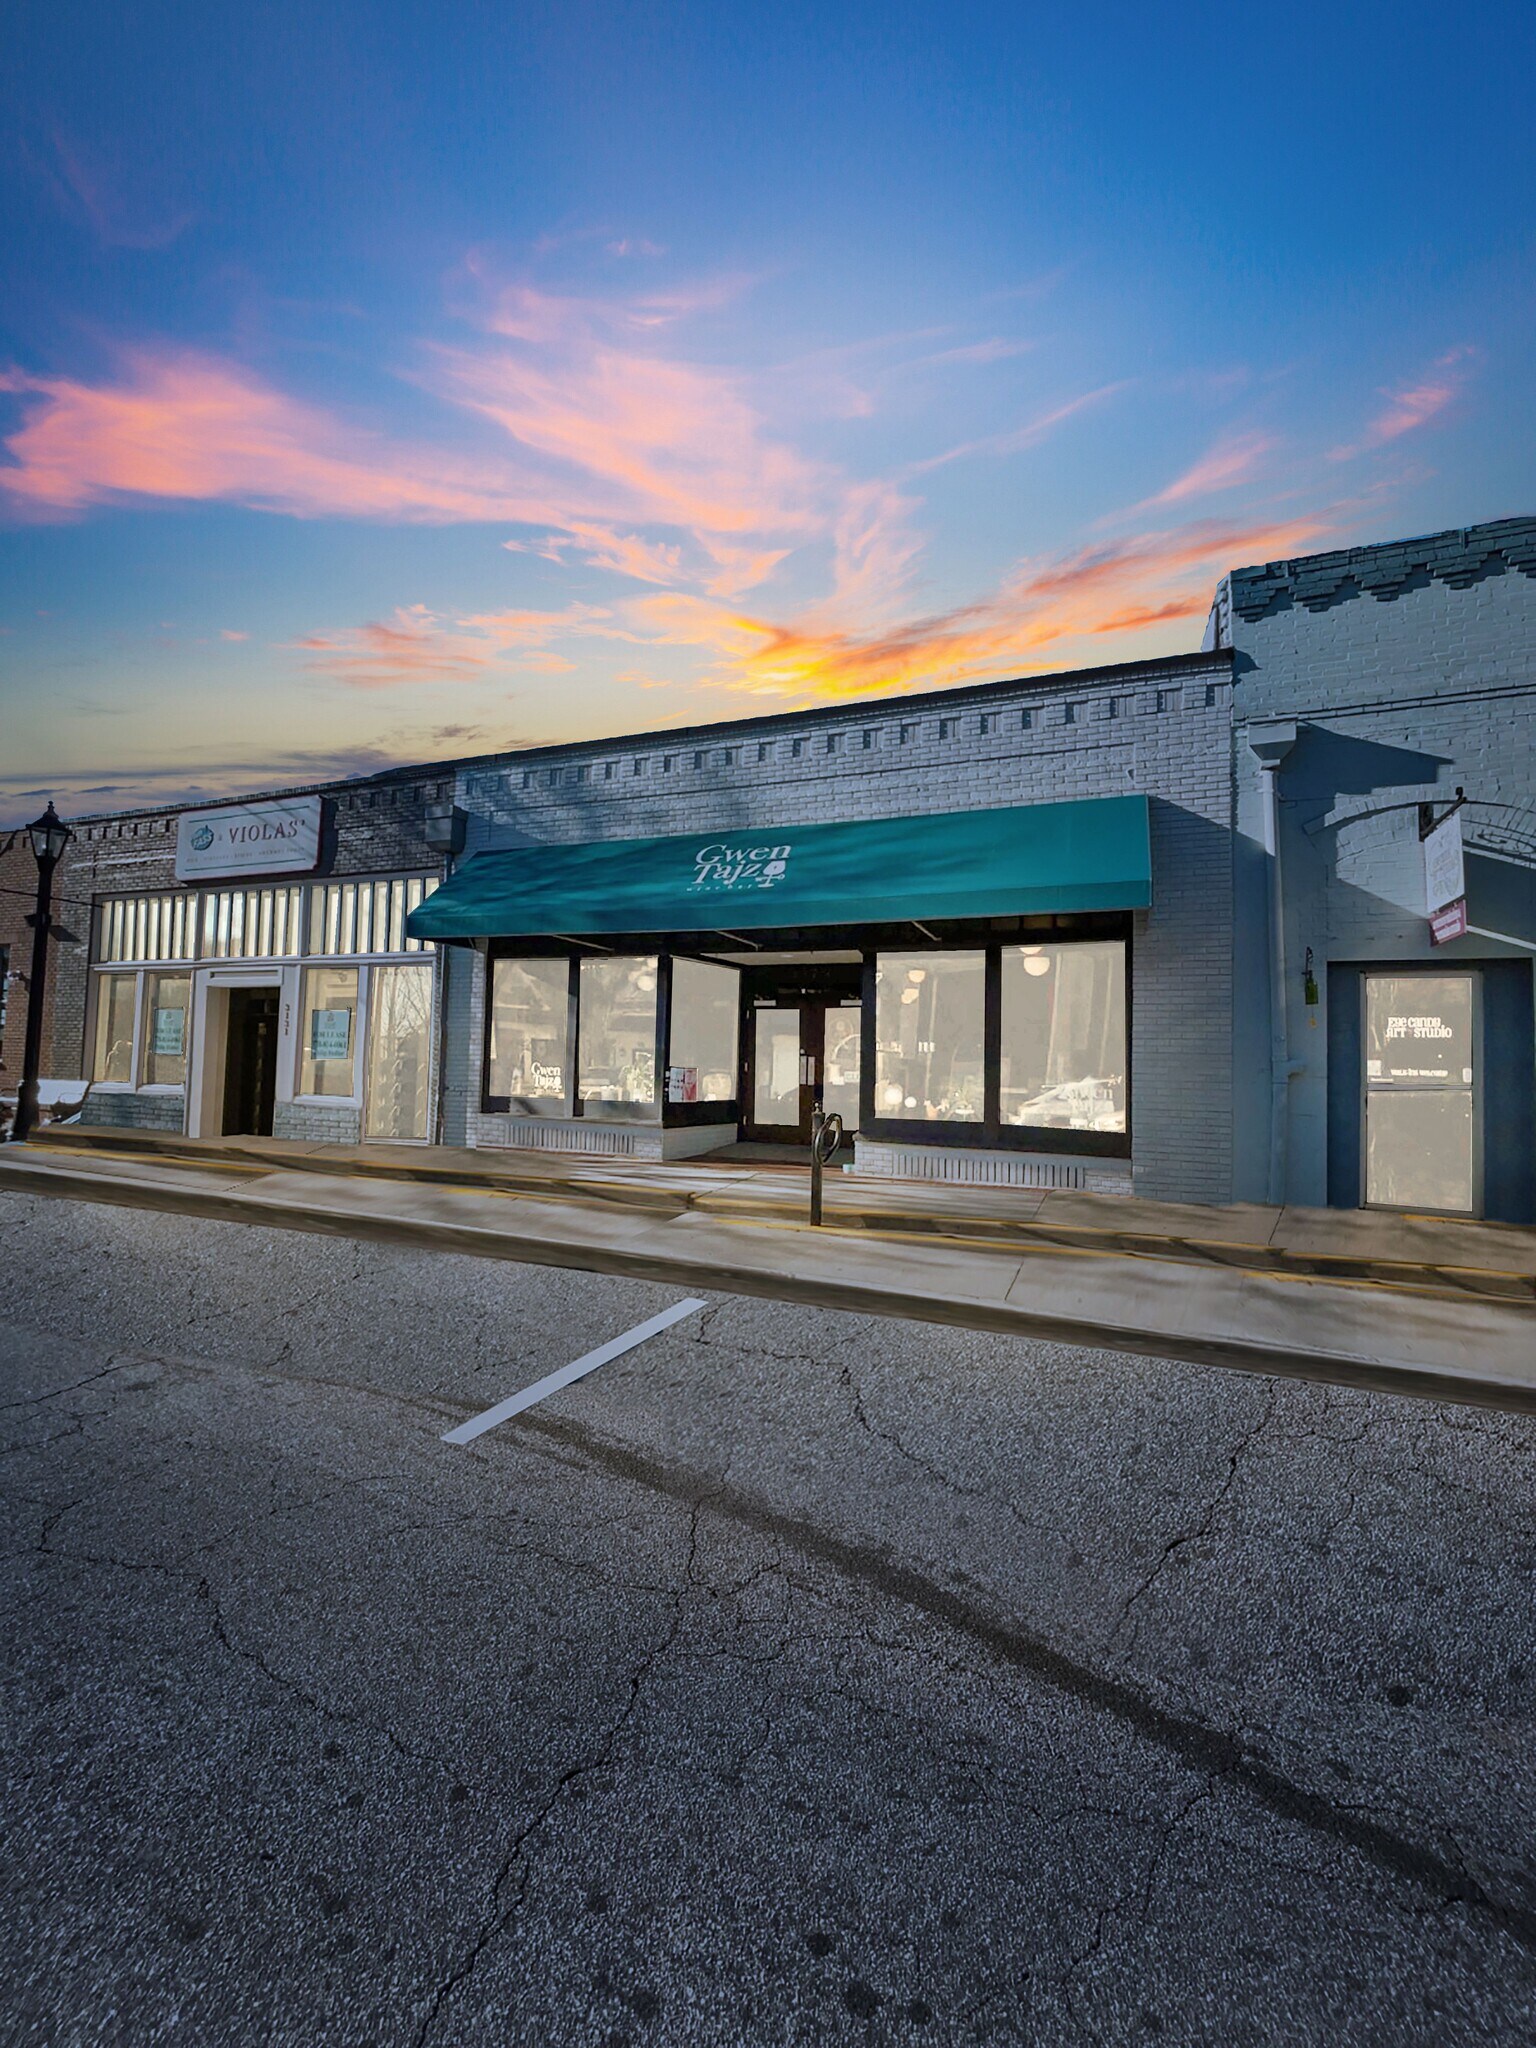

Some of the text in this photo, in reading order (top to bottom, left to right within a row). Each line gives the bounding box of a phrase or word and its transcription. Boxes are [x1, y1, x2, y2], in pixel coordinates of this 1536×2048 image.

[695, 844, 791, 864] Gwen
[691, 860, 762, 885] Tajz
[531, 1062, 561, 1076] Gwen
